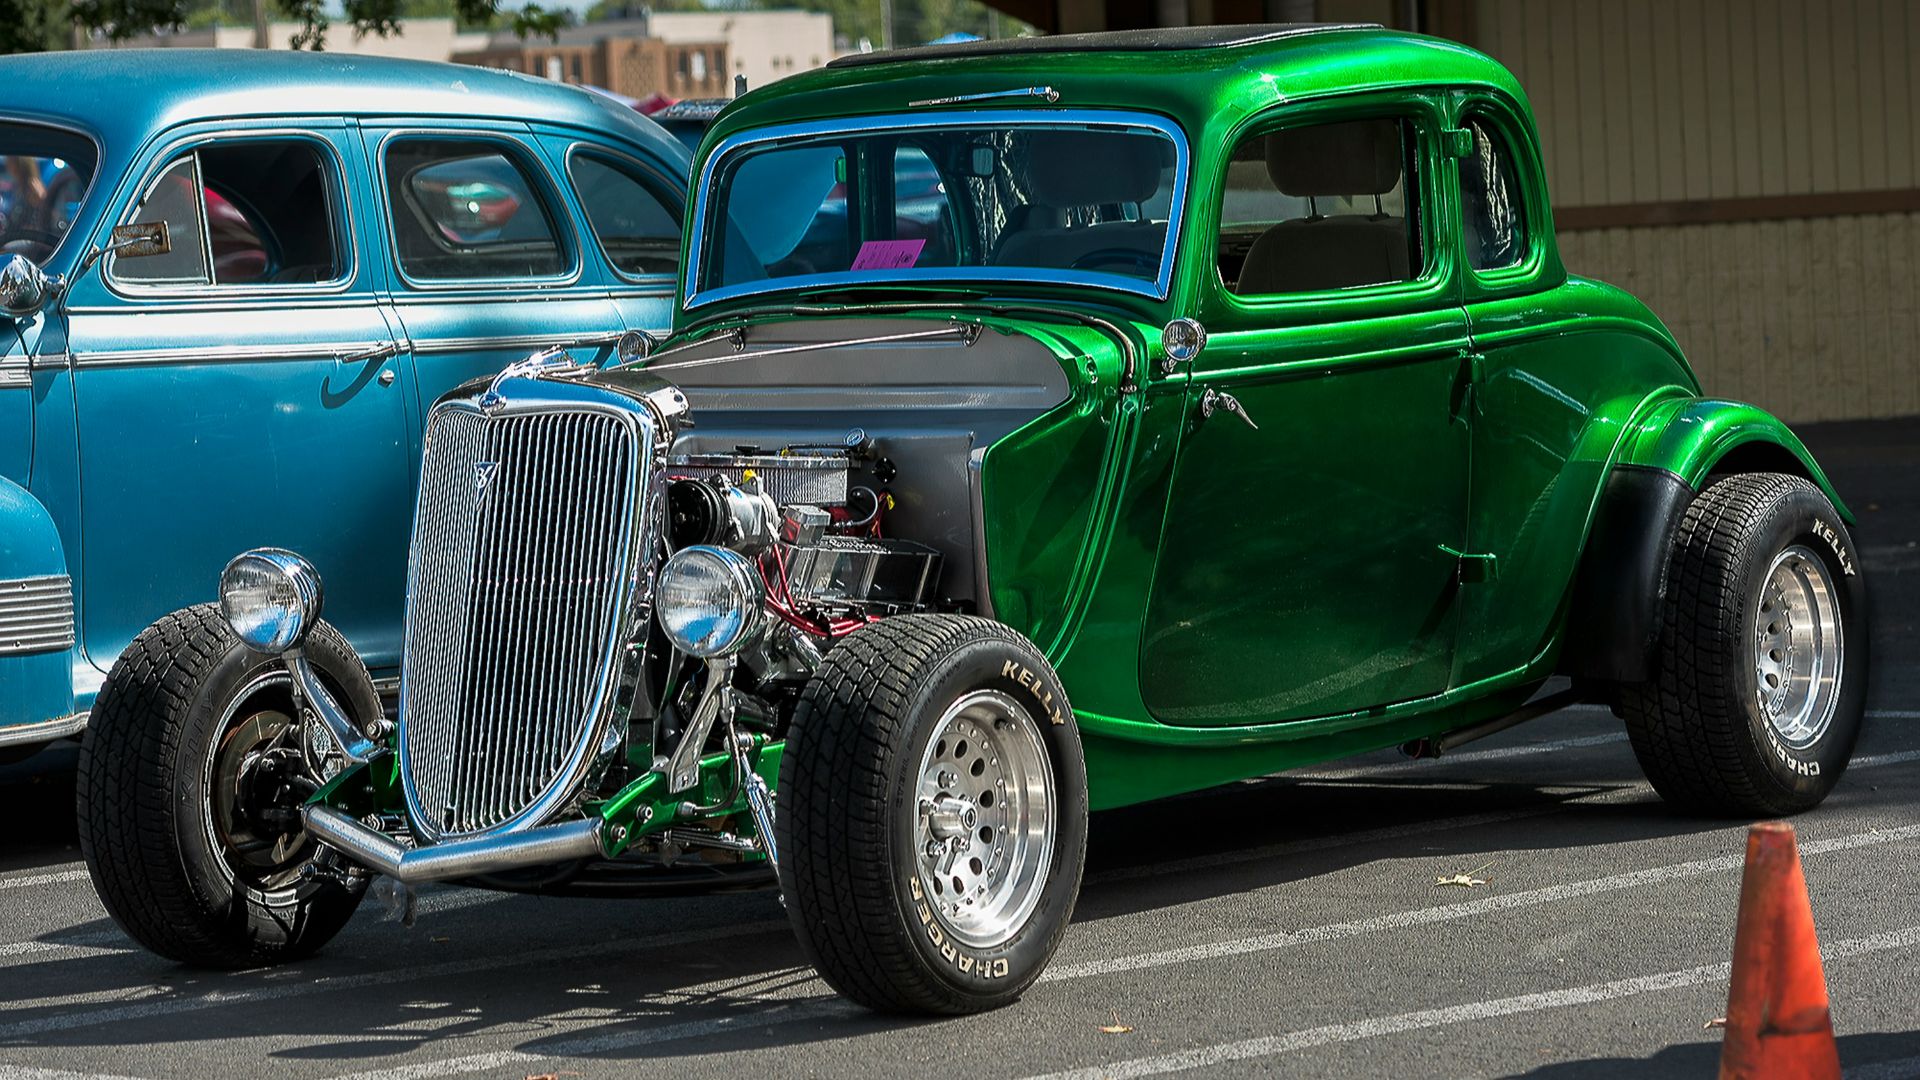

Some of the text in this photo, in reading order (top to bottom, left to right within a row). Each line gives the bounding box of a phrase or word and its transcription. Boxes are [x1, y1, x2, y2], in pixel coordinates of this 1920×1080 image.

[1812, 518, 1855, 576] KELLY
[1001, 659, 1064, 725] KELLY
[909, 876, 1008, 978] CHARGER
